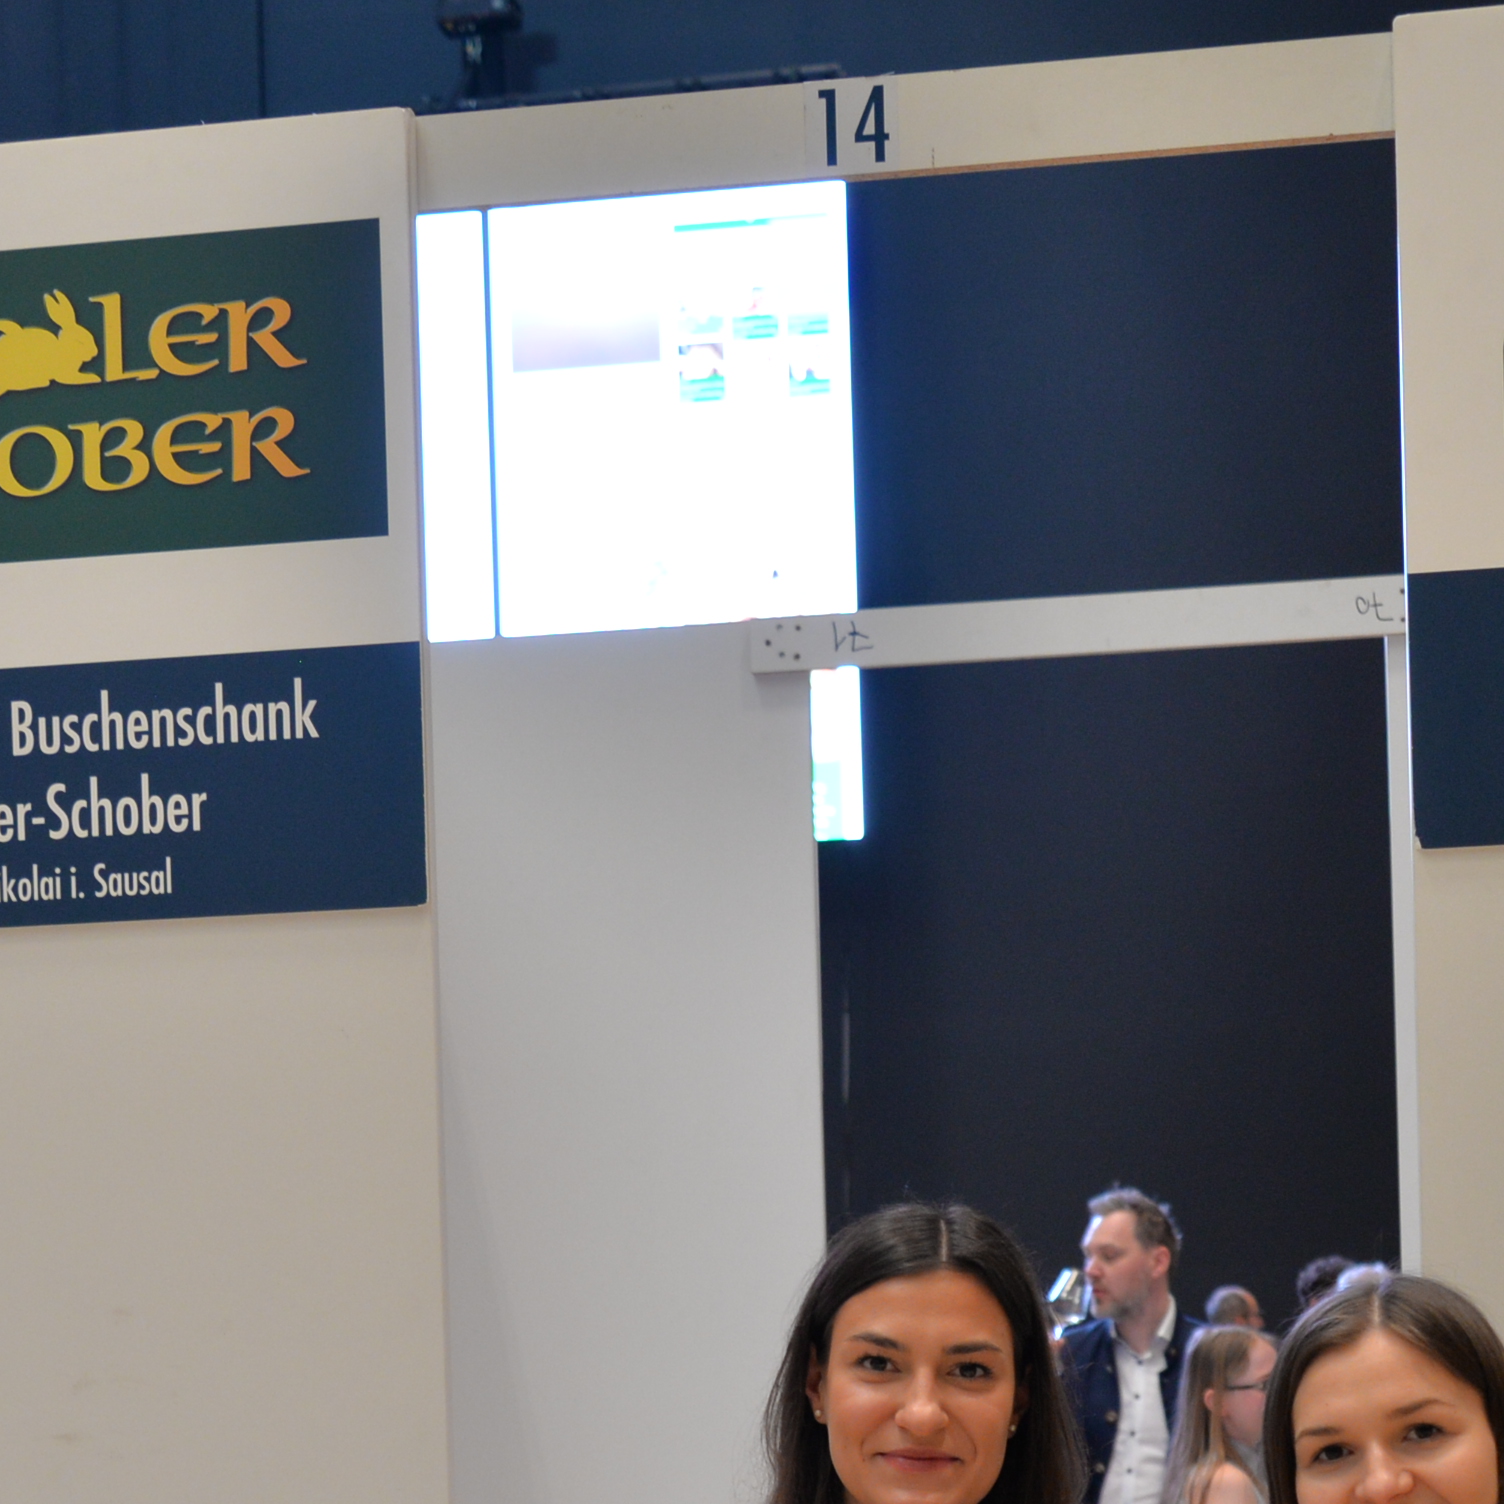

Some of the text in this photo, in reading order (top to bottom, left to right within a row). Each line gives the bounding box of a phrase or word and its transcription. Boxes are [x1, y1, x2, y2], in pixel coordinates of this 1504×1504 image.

[817, 85, 890, 167] 14
[10, 678, 320, 757] Buschenschank
[70, 866, 87, 901] i.
[93, 858, 173, 899] Sausal
